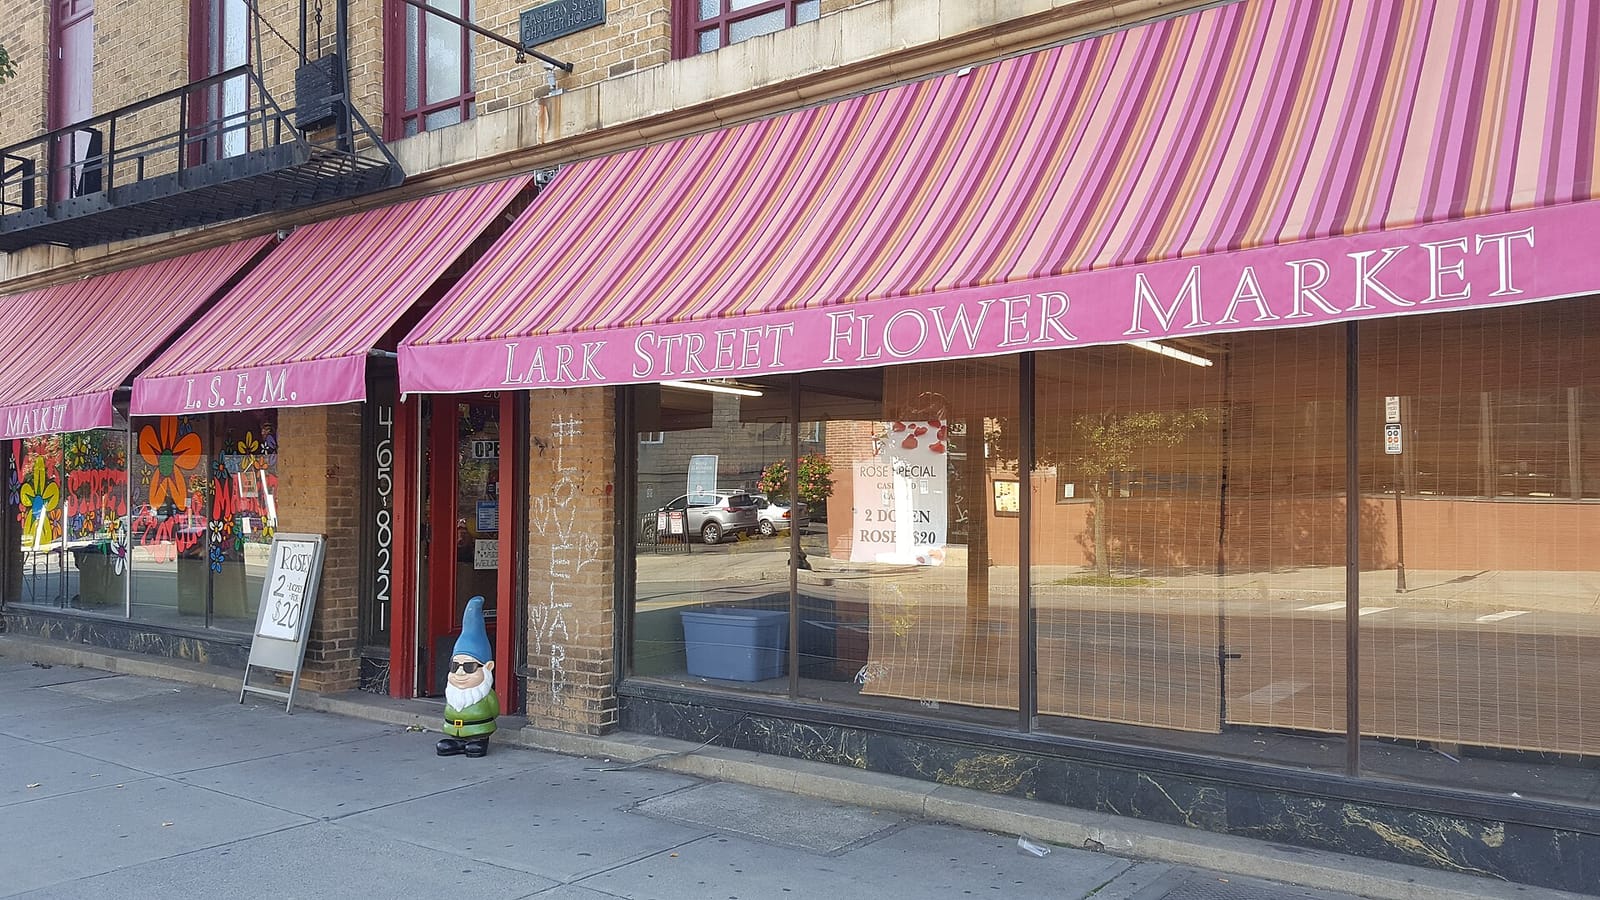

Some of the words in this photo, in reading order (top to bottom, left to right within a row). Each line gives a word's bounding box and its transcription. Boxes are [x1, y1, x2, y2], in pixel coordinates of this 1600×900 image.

[525, 2, 567, 27] EASTERN
[525, 17, 565, 40] CHAPTER
[568, 7, 598, 27] HOUSE
[501, 341, 608, 385] LARK
[632, 322, 794, 378] STREET
[822, 291, 1078, 364] FLOWER
[1122, 226, 1535, 336] MARKET
[475, 442, 500, 457] OPE
[860, 466, 888, 477] ROSE
[865, 509, 872, 521] 2
[877, 510, 931, 523] DOEN
[860, 529, 898, 543] ROSE
[273, 574, 286, 598] 2
[272, 600, 299, 629] $20
